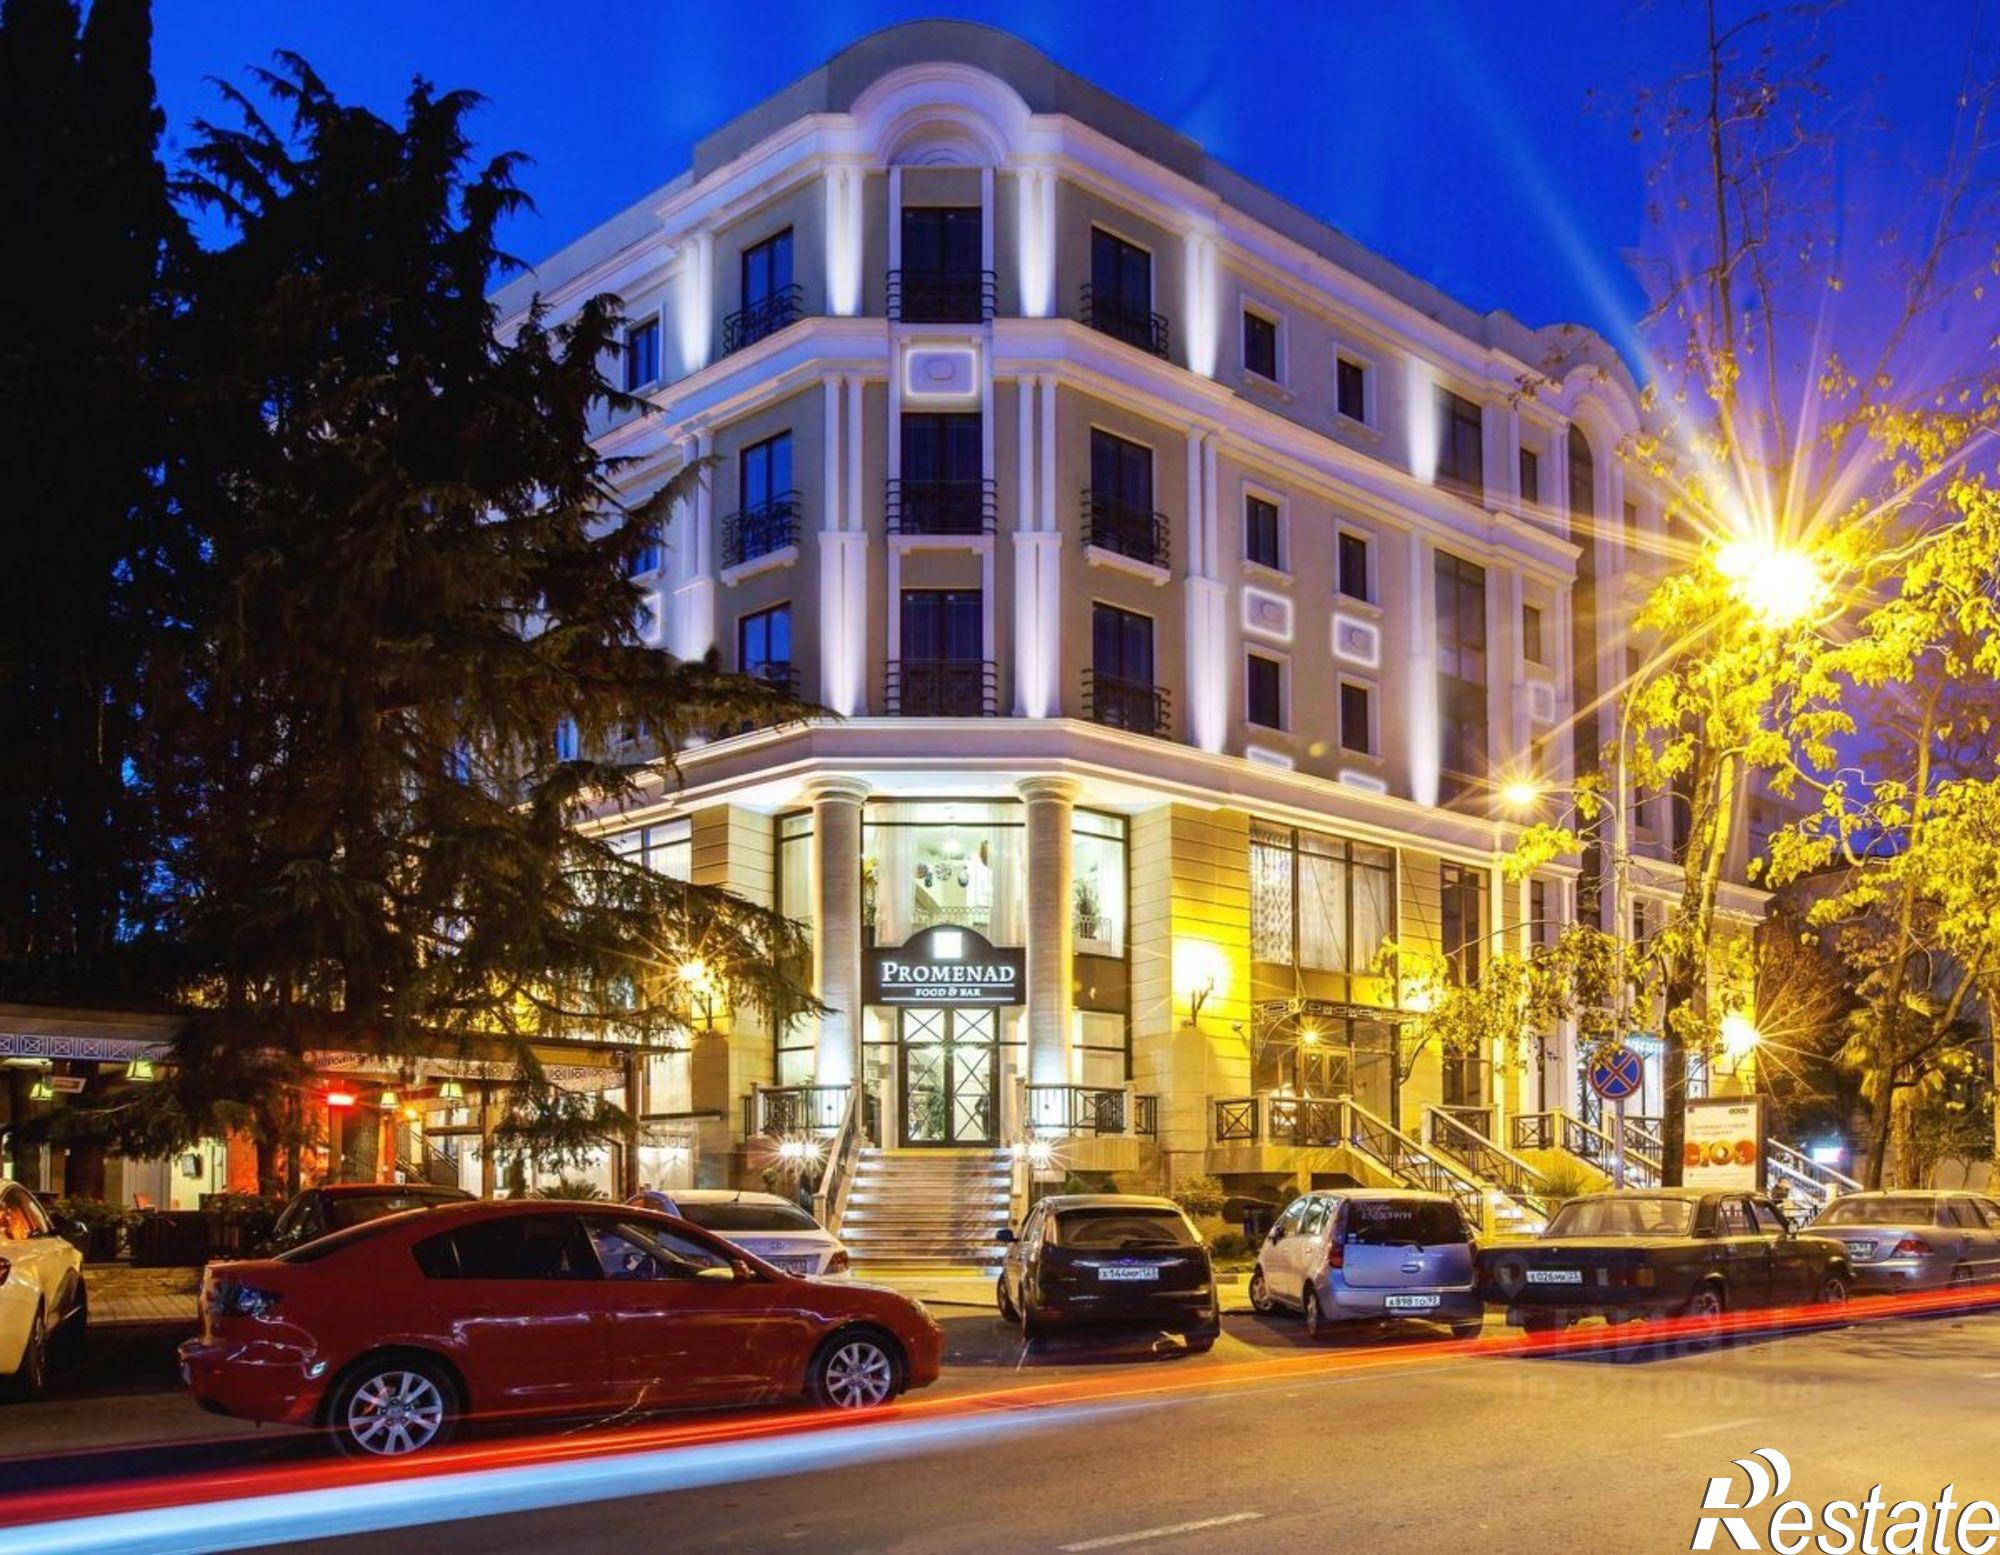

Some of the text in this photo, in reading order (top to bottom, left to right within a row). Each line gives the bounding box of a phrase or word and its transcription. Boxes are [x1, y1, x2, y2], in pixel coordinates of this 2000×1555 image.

[881, 961, 1015, 982] PROMENAD
[915, 986, 981, 997] FOOD & BAR
